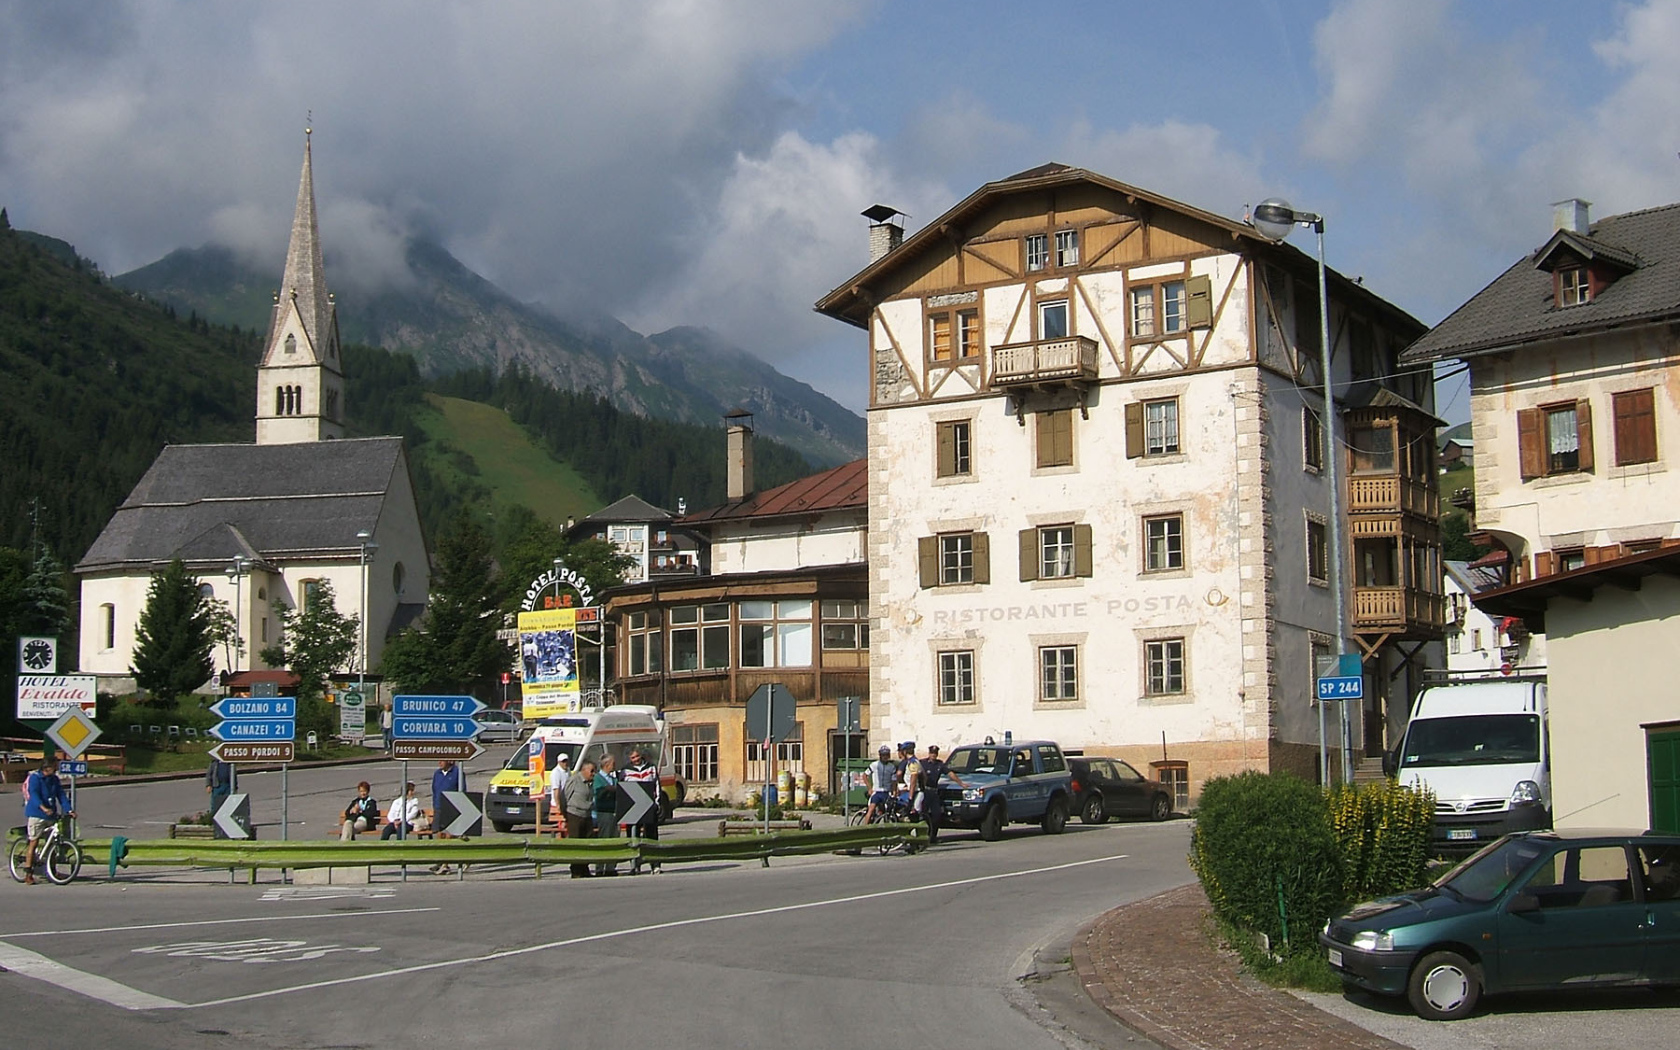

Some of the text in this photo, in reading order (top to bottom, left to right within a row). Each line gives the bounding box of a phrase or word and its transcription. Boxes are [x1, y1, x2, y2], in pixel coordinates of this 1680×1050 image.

[521, 568, 594, 611] HOTEL POSTA
[544, 594, 573, 609] BAR
[933, 594, 1194, 624] RISTORANTE POSTA
[20, 677, 69, 687] HOTEL
[20, 688, 88, 699] Evaldo
[1320, 681, 1359, 695] SP 244
[32, 701, 81, 709] RISTORANTE
[229, 703, 287, 714] BOLZANO 84
[402, 700, 464, 712] BRUNICO 47
[230, 724, 285, 735] CANAZEI 21
[402, 722, 464, 733] CORVARA 10
[223, 747, 291, 757] PASSO PORDOI 9
[395, 746, 416, 754] PASSO
[418, 746, 462, 754] CAMPOLONGO
[61, 763, 85, 773] SR 48
